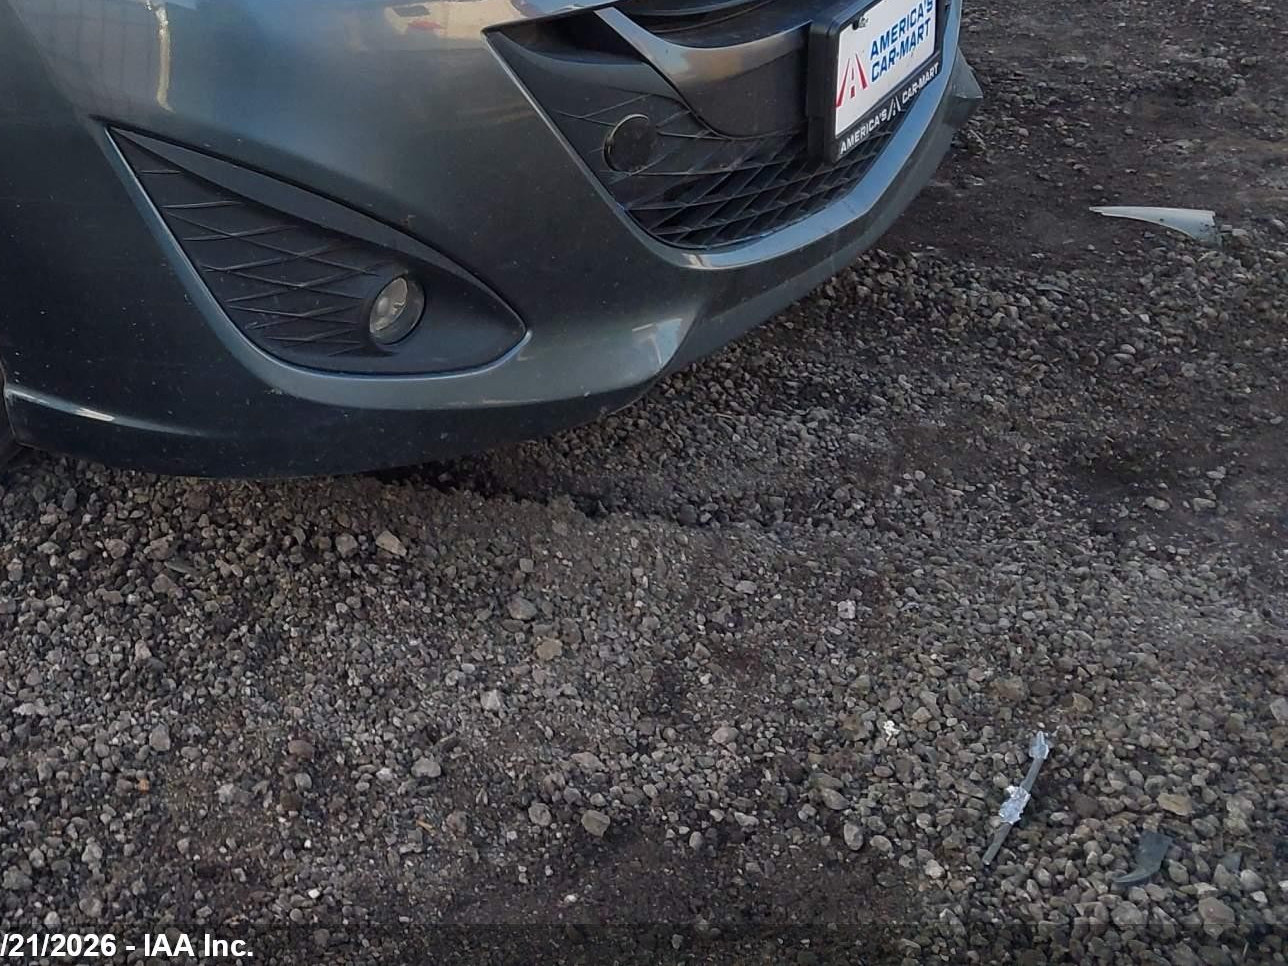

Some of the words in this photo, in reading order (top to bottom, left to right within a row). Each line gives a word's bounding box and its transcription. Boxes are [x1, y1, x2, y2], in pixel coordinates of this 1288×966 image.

[871, 17, 931, 83] CAR-MART
[840, 108, 888, 154] AMERICA'S
[901, 61, 940, 105] CAR-MART
